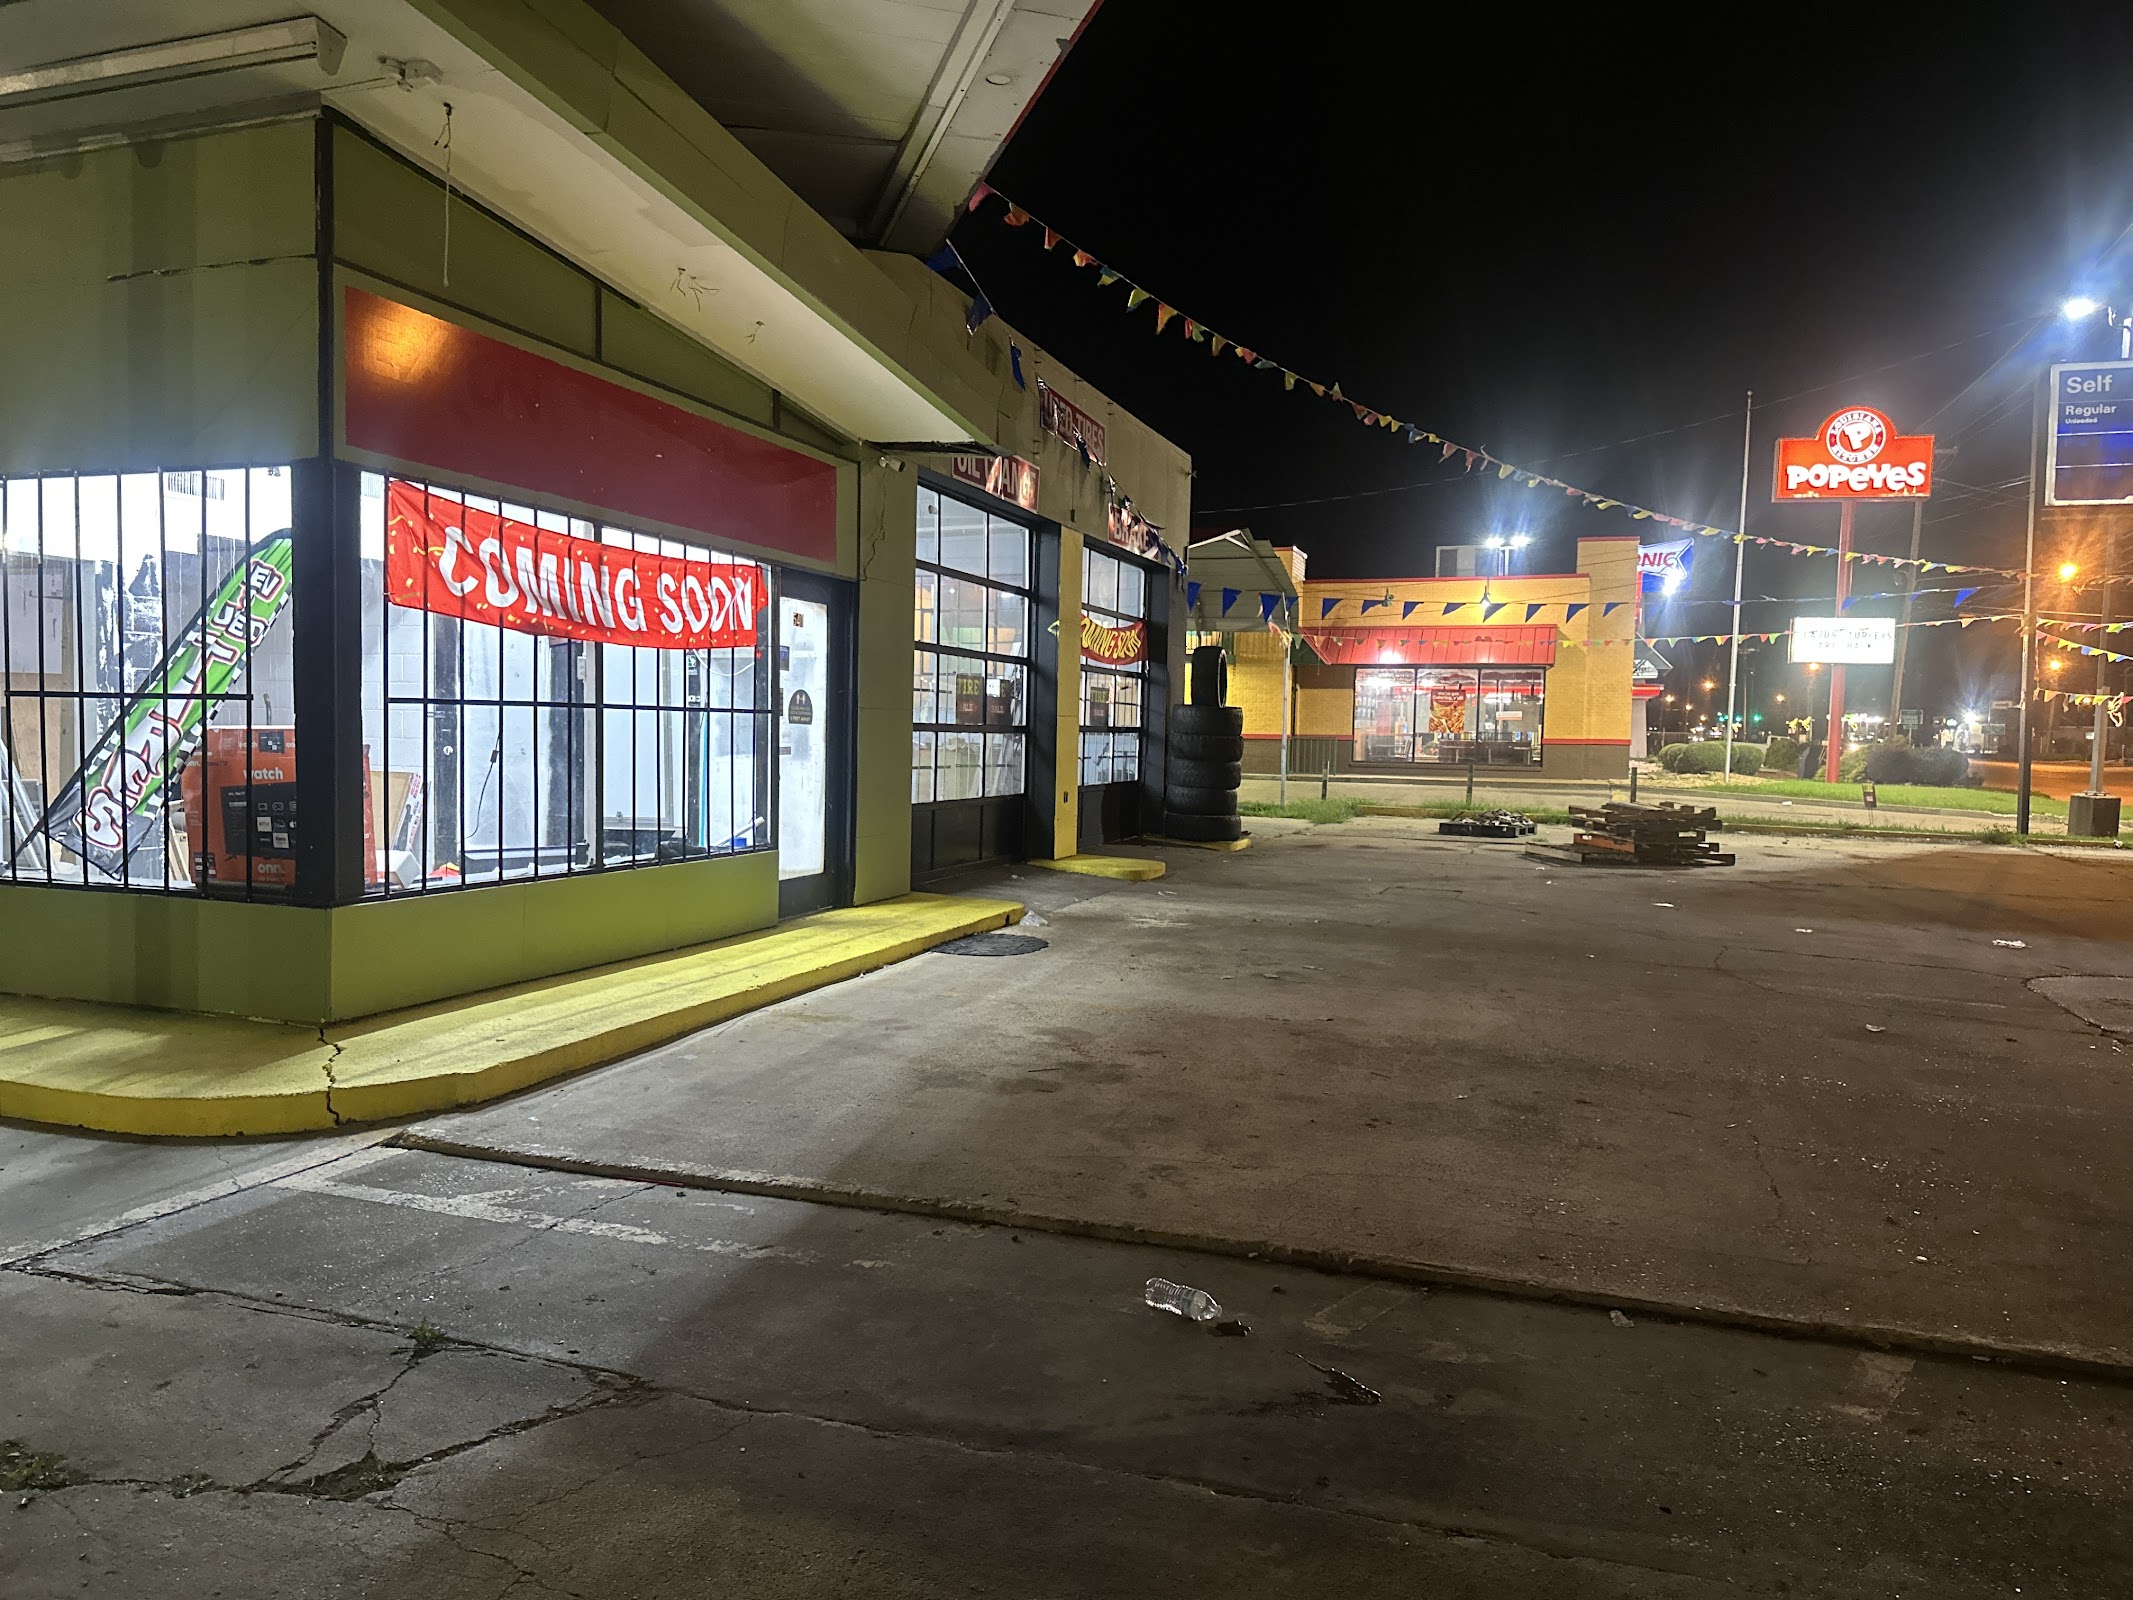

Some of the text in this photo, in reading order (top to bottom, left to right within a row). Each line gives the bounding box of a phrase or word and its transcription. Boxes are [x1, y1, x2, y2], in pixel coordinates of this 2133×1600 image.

[2066, 374, 2113, 394] Self
[2065, 404, 2117, 417] Regular
[1638, 552, 1676, 567] NIC
[438, 526, 753, 634] COMING SOON
